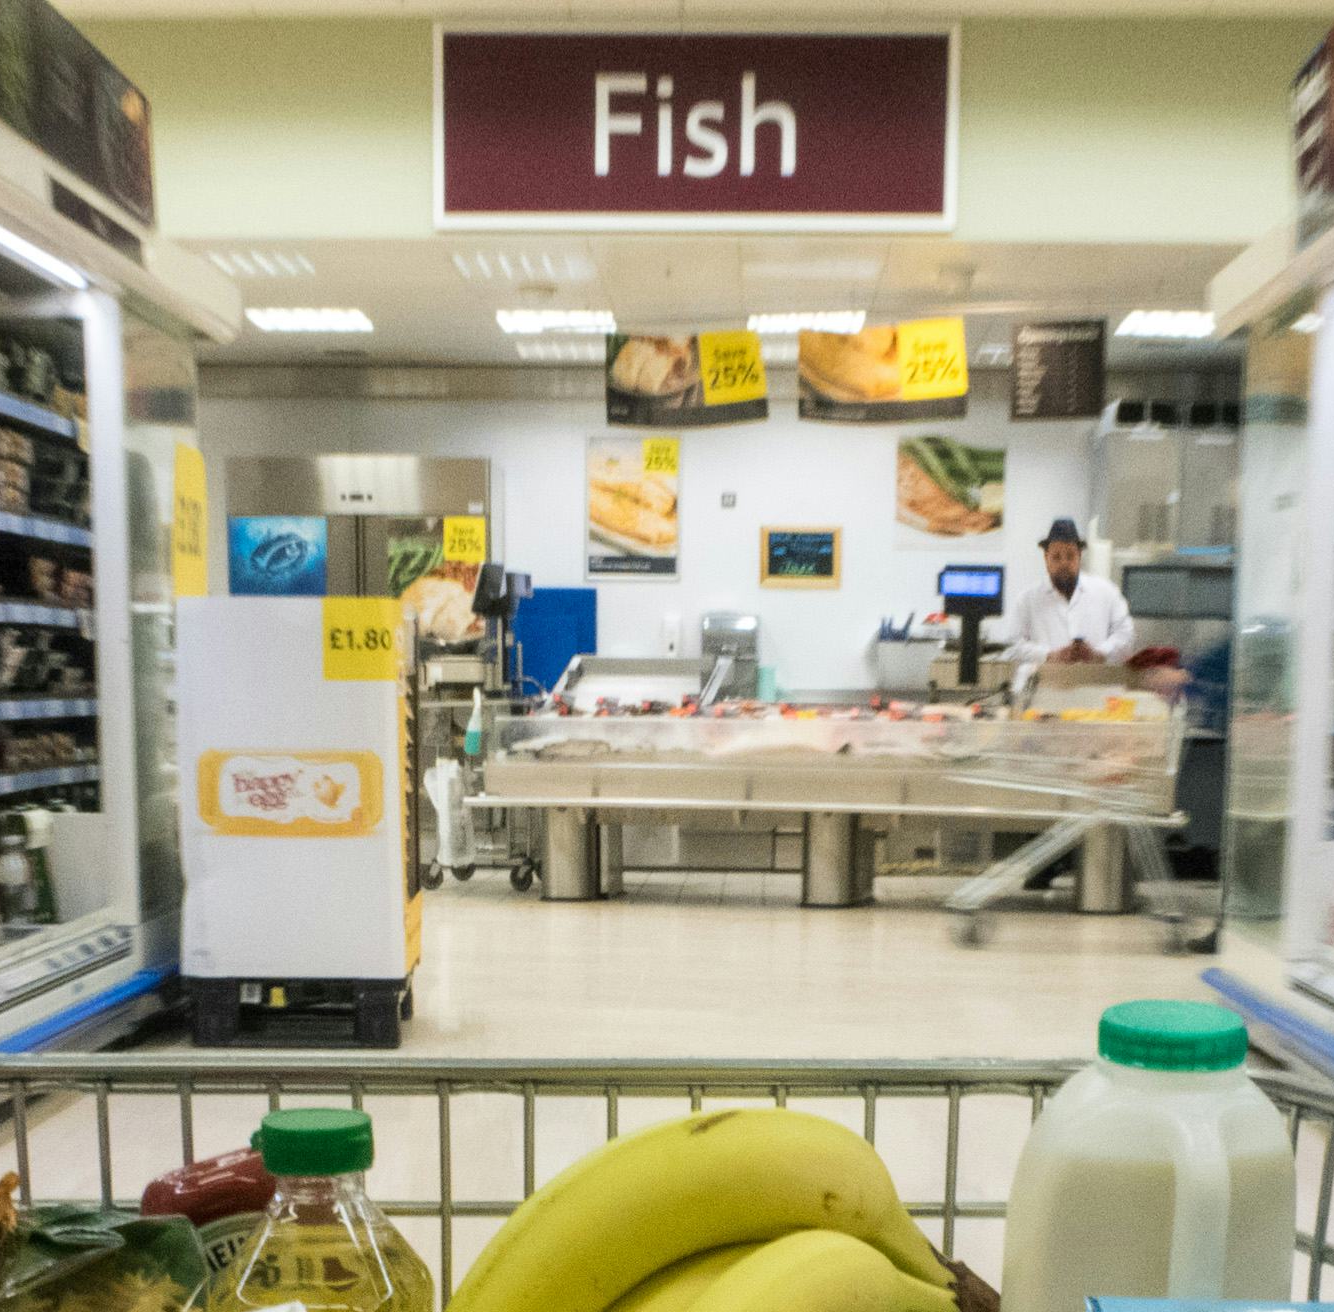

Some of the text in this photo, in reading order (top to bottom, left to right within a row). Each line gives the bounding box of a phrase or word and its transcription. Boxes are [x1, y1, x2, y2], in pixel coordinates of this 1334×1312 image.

[594, 71, 797, 178] Fish
[708, 361, 761, 391] 25%
[906, 353, 961, 387] 25%
[330, 627, 393, 652] £1.80
